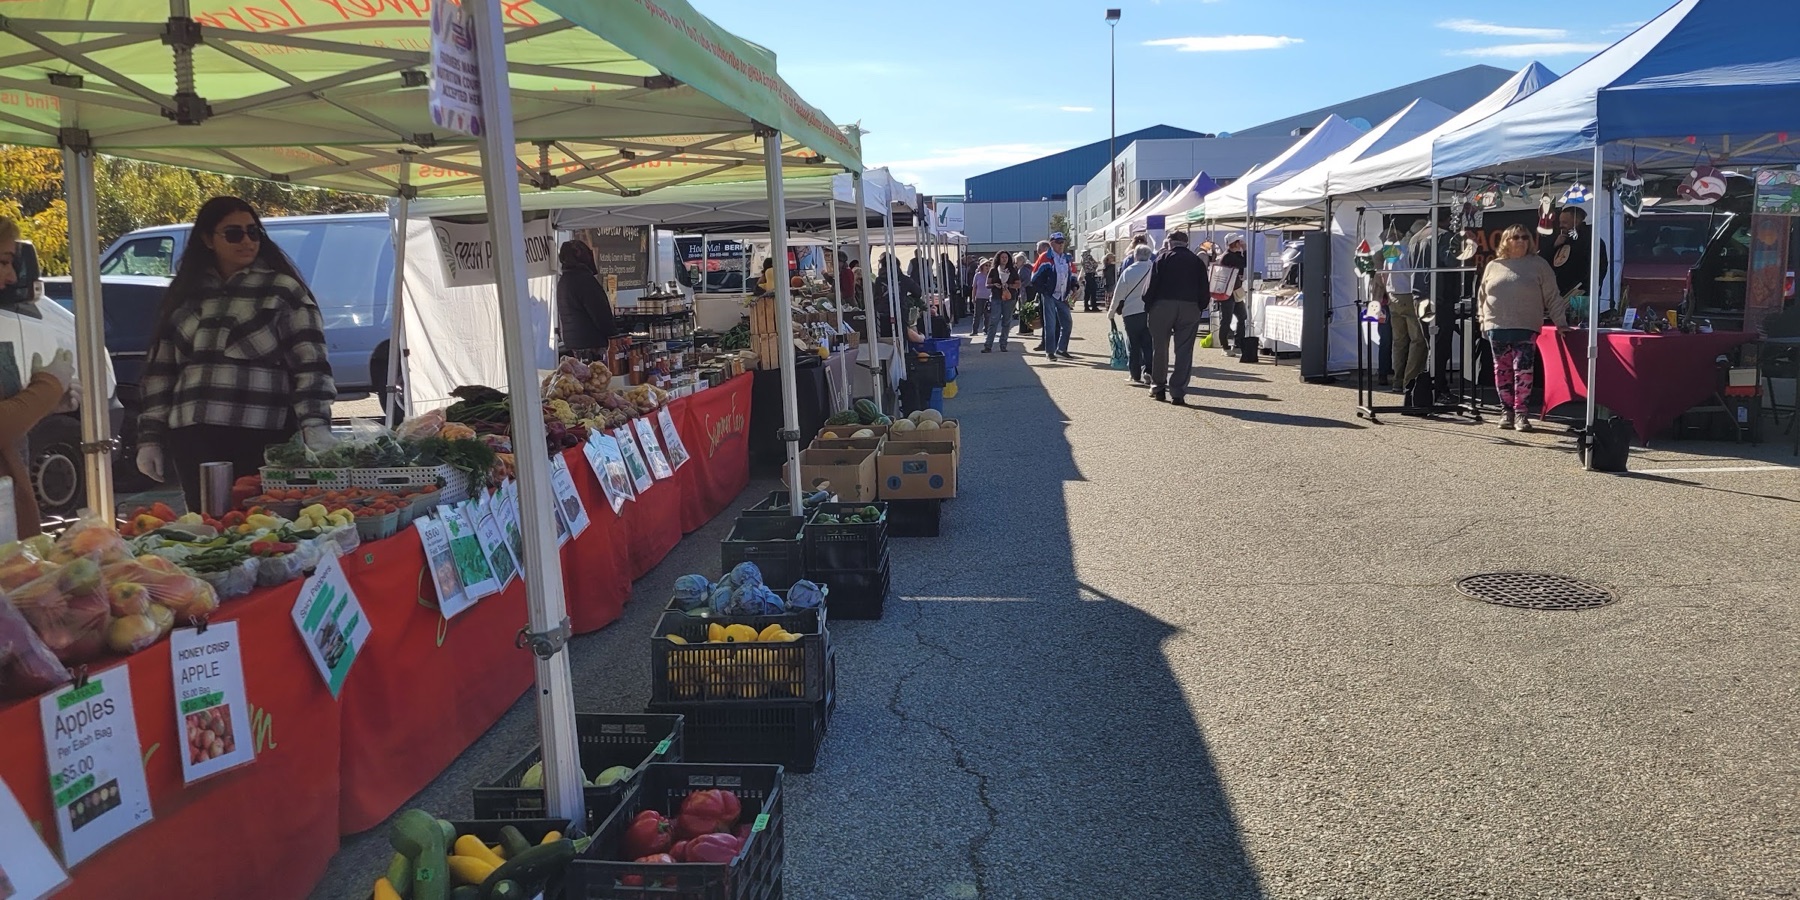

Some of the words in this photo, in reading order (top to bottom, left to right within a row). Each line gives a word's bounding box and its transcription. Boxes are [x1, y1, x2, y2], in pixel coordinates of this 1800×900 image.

[178, 645, 205, 661] HONEY
[205, 640, 230, 655] CRISP
[180, 661, 221, 685] APPLE
[54, 697, 115, 741] Apples
[72, 734, 93, 752] Each
[93, 726, 113, 740] Bag
[62, 755, 95, 785] $5.00
